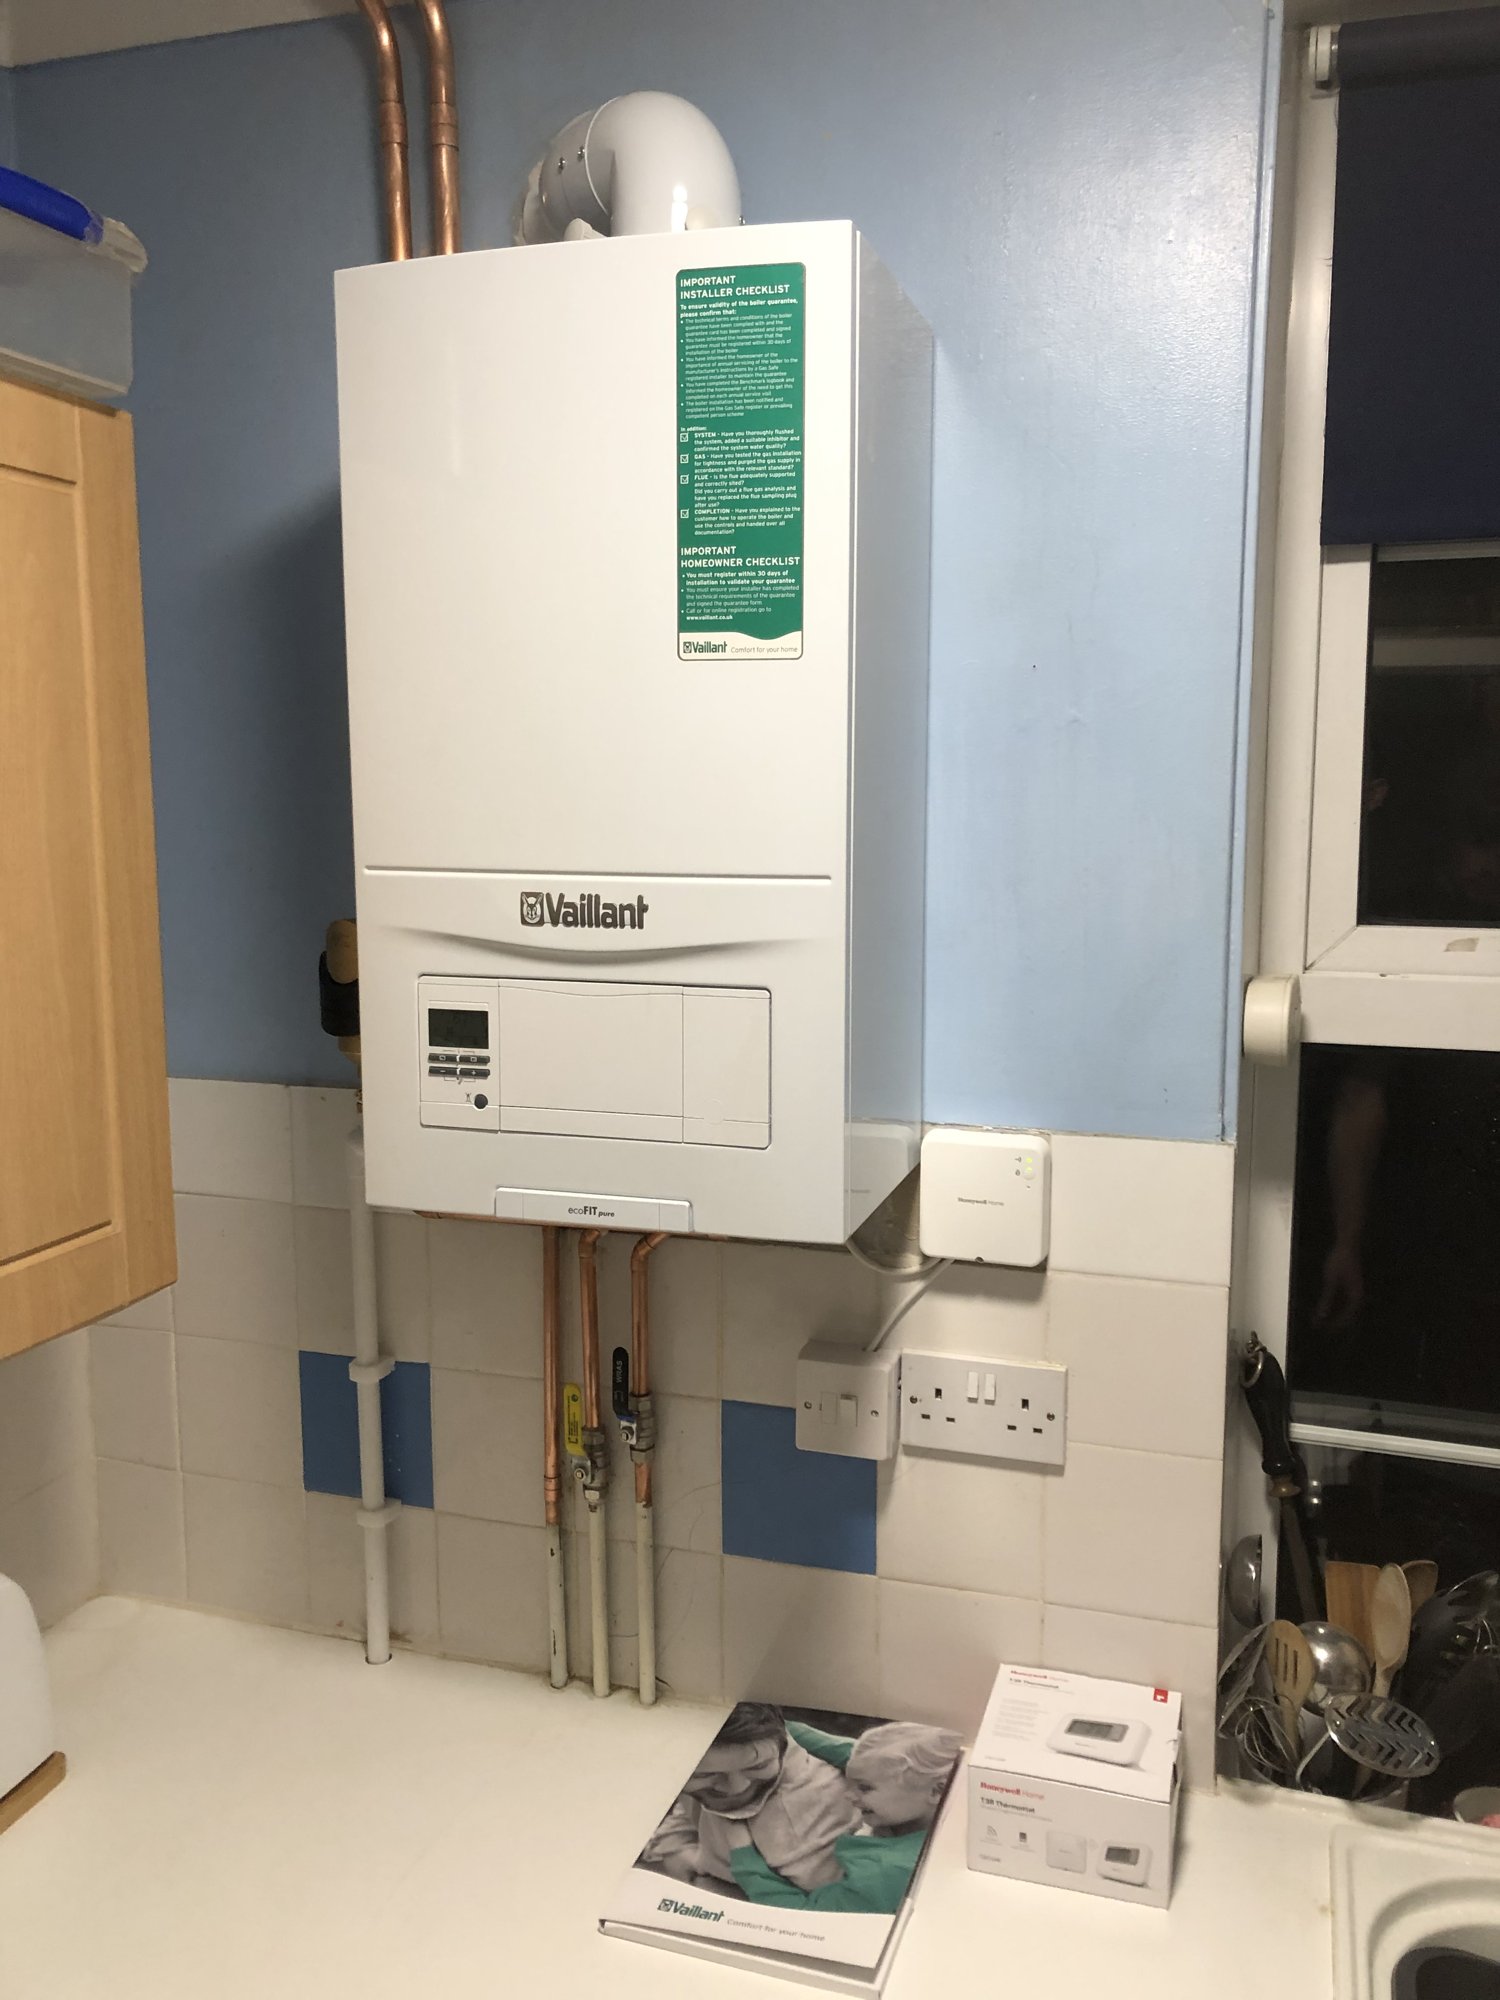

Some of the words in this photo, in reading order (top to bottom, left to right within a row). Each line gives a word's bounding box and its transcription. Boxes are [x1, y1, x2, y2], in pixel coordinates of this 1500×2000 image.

[681, 275, 736, 287] IMPORTANT
[681, 288, 733, 299] INSTALLER
[735, 285, 790, 296] CHECKLIST
[709, 300, 730, 309] validity
[750, 298, 766, 306] boiler
[767, 296, 798, 306] guarantee,
[680, 310, 698, 319] please
[700, 309, 721, 317] confirm
[681, 547, 736, 556] IMPORTANT
[681, 558, 744, 568] HOMEOWNER
[746, 557, 800, 566] CHECKLIST
[714, 570, 737, 579] register
[767, 569, 781, 578] days
[766, 577, 795, 585] guarantee
[692, 641, 727, 653] Vaillant
[546, 892, 649, 930] Vaillant
[568, 1206, 598, 1215] ecoFIT
[673, 1901, 724, 1922] Vaillant
[727, 1918, 764, 1930] Comfort
